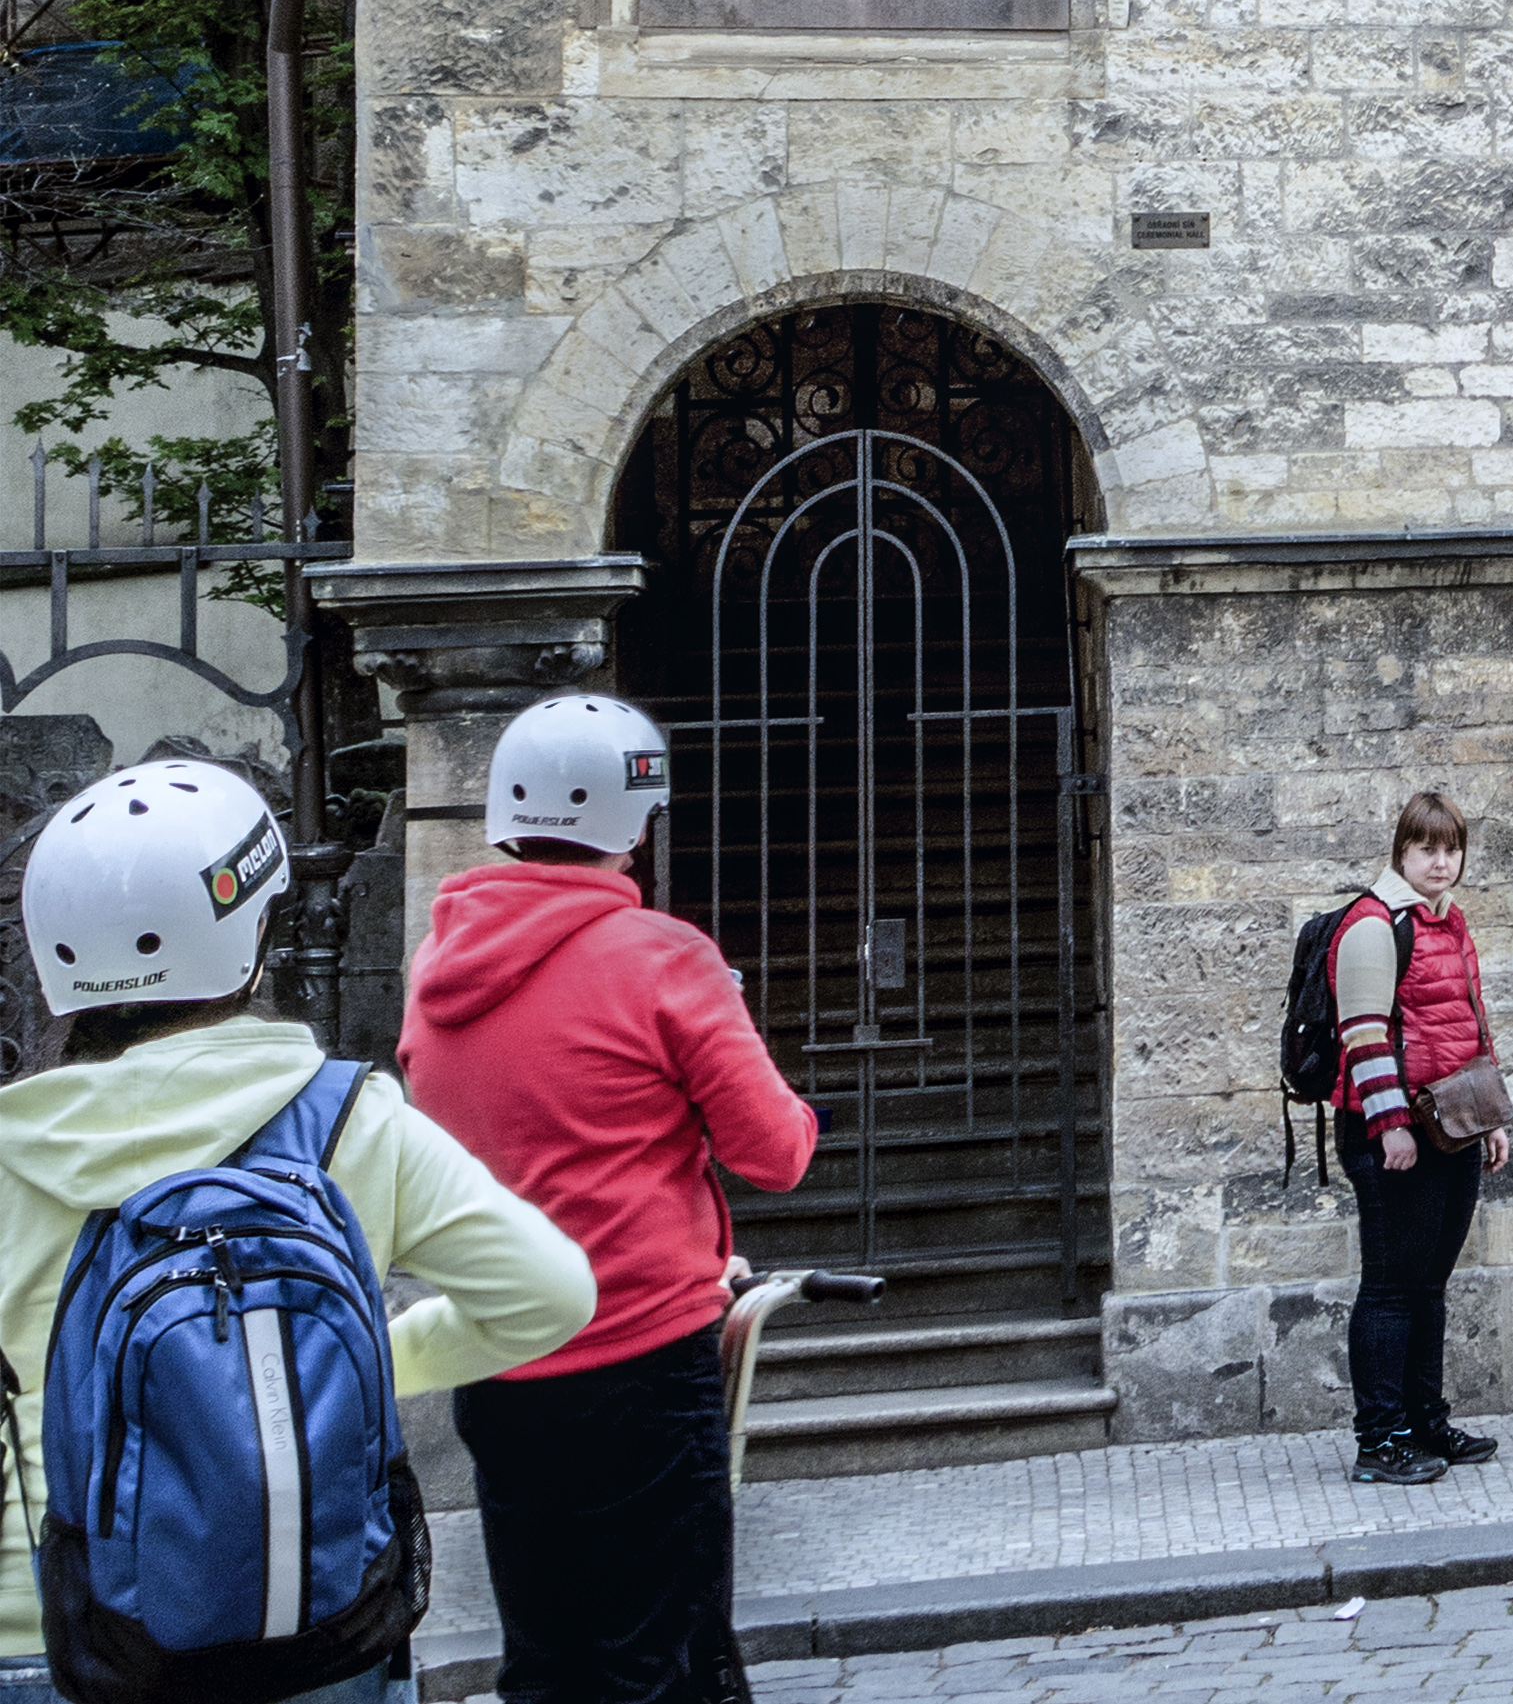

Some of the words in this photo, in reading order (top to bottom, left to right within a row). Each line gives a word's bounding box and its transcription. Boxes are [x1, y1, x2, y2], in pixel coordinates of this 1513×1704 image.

[1136, 231, 1184, 239] CEREMONIAL
[1186, 231, 1205, 239] HALL
[511, 813, 582, 827] POWERSLIDE
[72, 968, 171, 993] POWERSLIDE
[261, 1352, 282, 1404] Calvin
[270, 1406, 289, 1451] Klein
